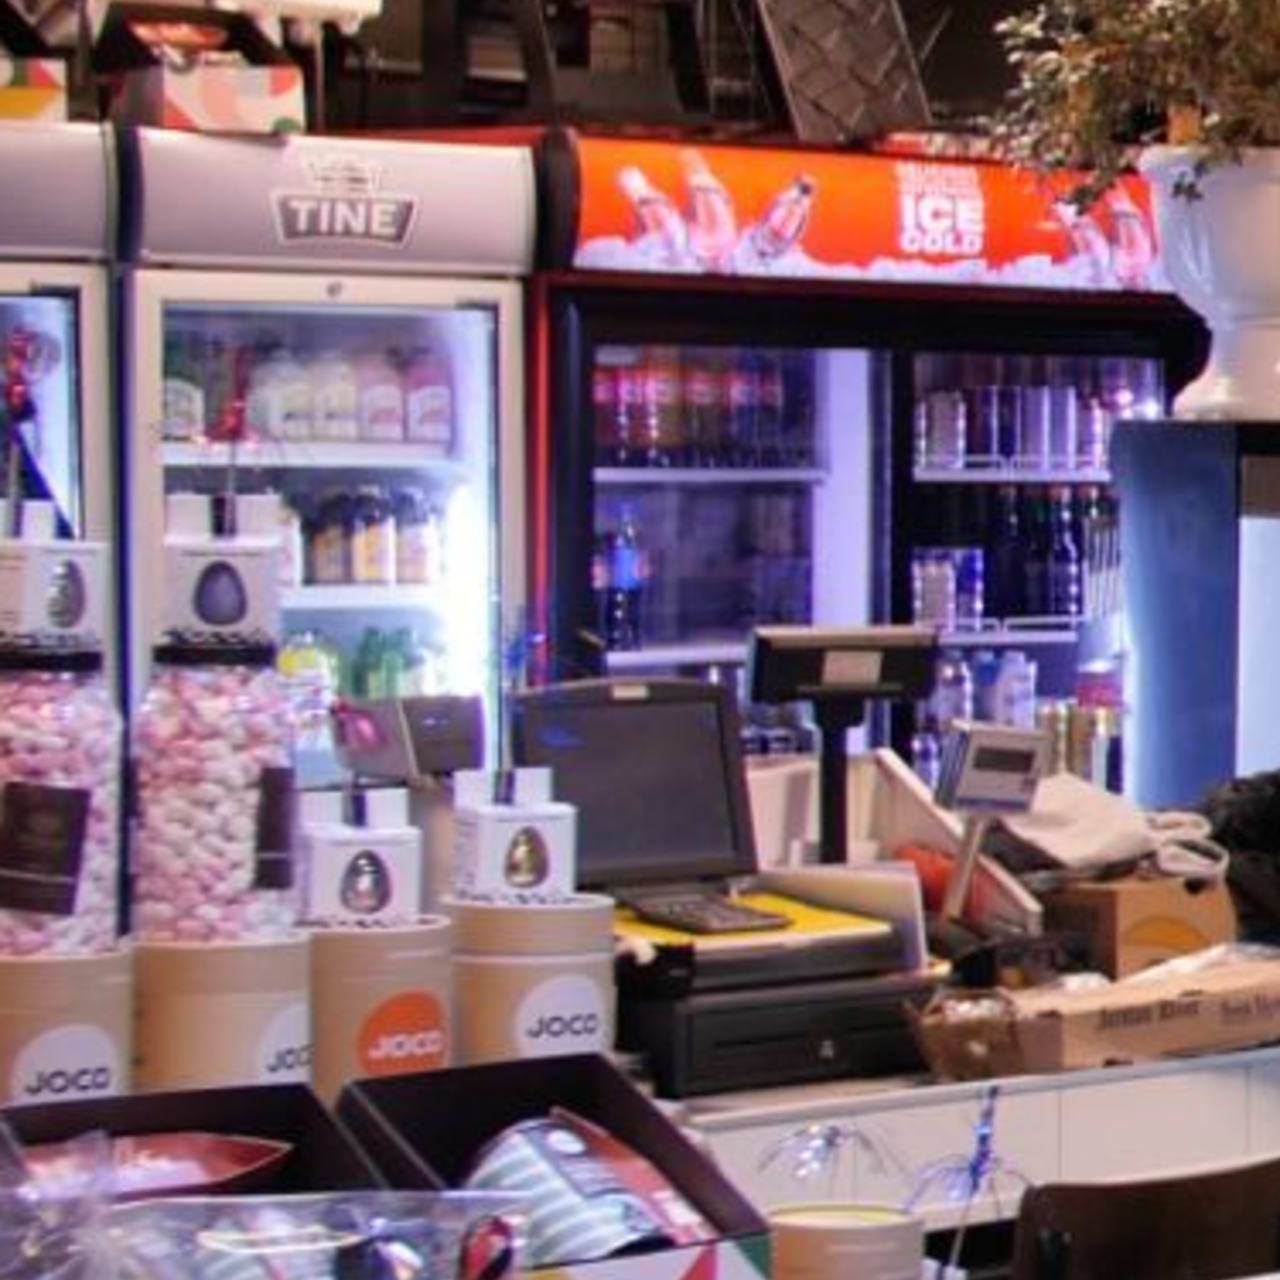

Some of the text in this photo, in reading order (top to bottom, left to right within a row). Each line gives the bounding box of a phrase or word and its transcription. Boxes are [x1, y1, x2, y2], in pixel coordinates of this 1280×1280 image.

[287, 199, 398, 237] TINE
[902, 195, 984, 233] ICE
[900, 228, 984, 255] COLD
[525, 1013, 598, 1039] JOCO
[265, 1043, 313, 1073] JOC
[368, 1030, 443, 1060] JOCO
[25, 1067, 110, 1095] JOCO
